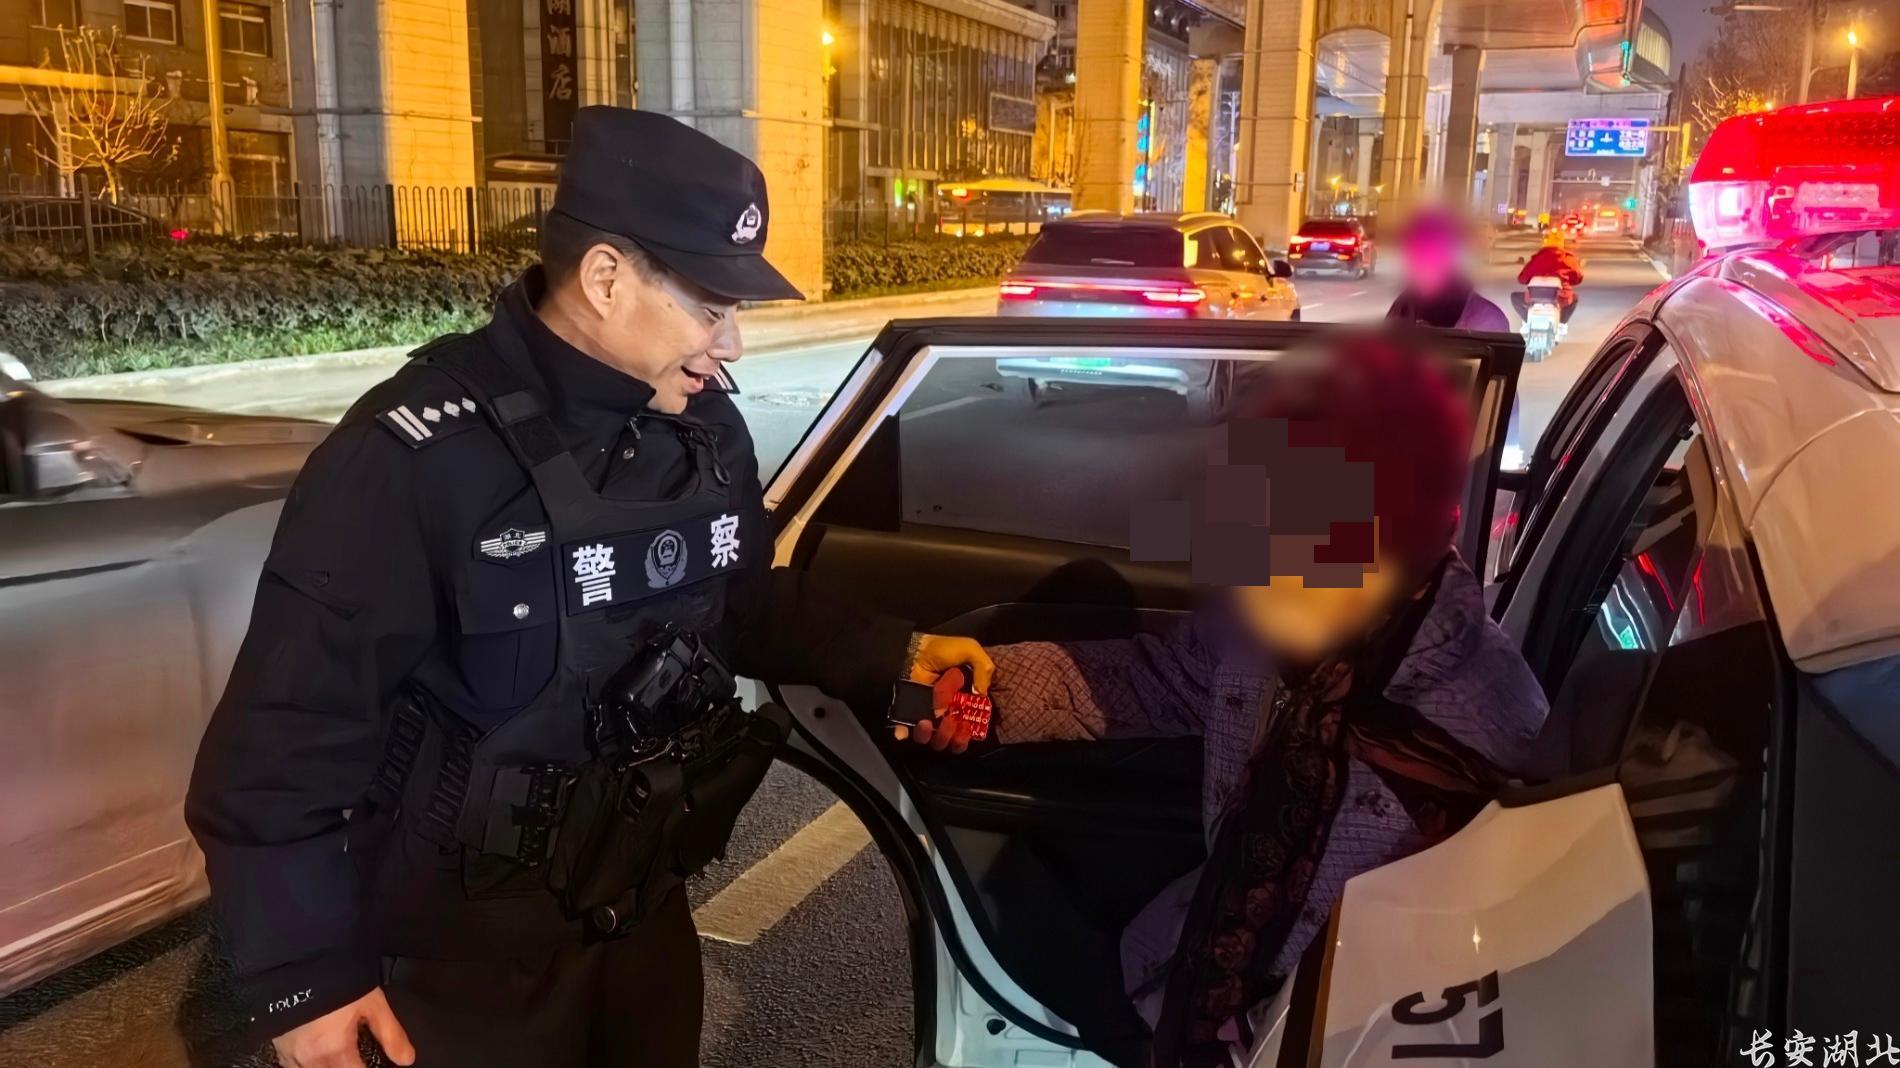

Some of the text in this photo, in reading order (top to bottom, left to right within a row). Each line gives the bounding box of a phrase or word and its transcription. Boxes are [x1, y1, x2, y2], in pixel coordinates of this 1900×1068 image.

[572, 513, 741, 607] 警 察
[1391, 969, 1505, 1060] 57
